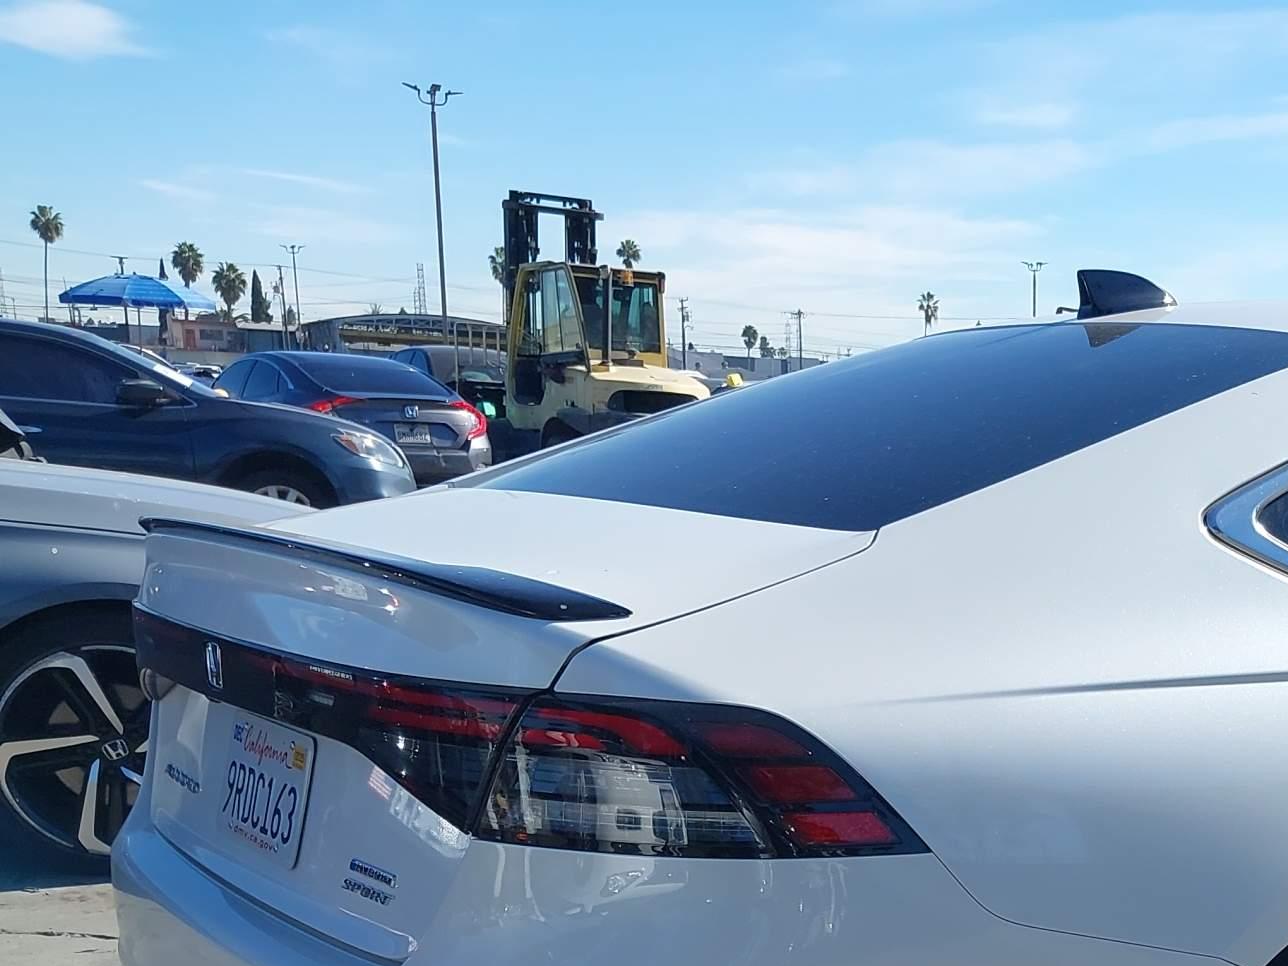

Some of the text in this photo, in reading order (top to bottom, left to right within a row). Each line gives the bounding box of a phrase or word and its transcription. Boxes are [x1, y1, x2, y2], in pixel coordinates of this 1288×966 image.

[243, 725, 292, 767] California
[222, 760, 298, 845] 9RDC163
[342, 878, 394, 905] SPORT
